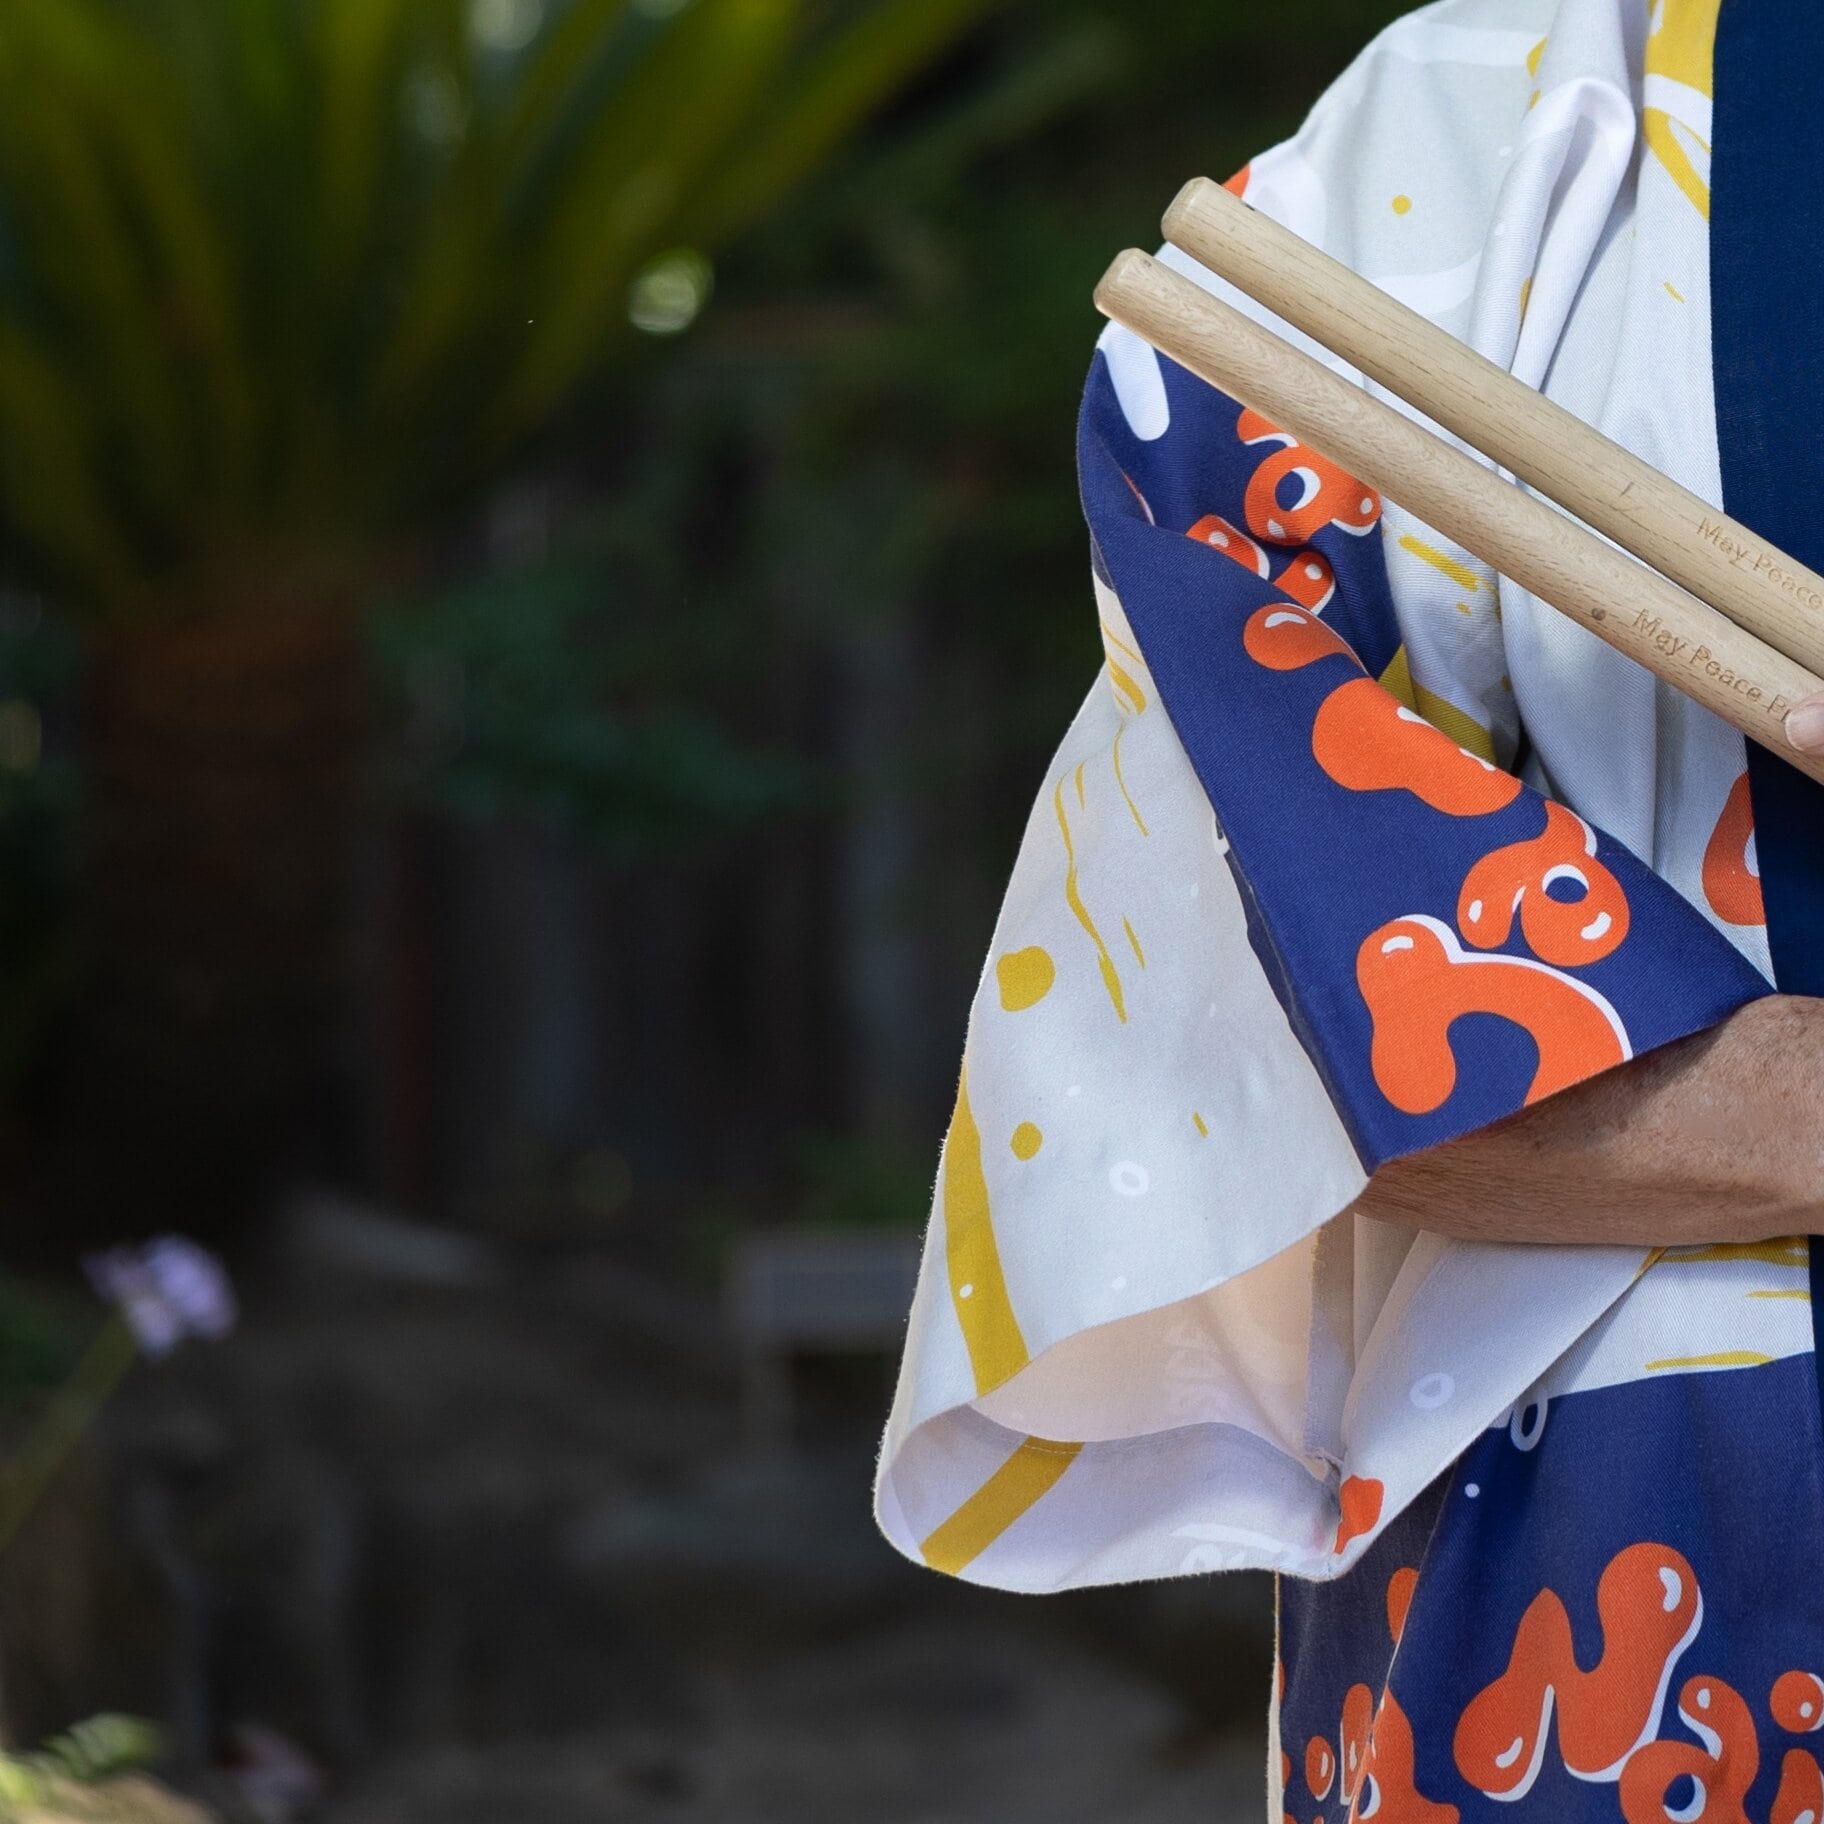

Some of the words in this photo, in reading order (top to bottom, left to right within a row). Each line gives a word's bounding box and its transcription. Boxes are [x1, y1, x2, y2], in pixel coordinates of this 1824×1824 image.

[1696, 516, 1748, 566] May
[1752, 552, 1824, 610] Peace
[1632, 608, 1687, 656] May
[1689, 643, 1764, 703] Peace
